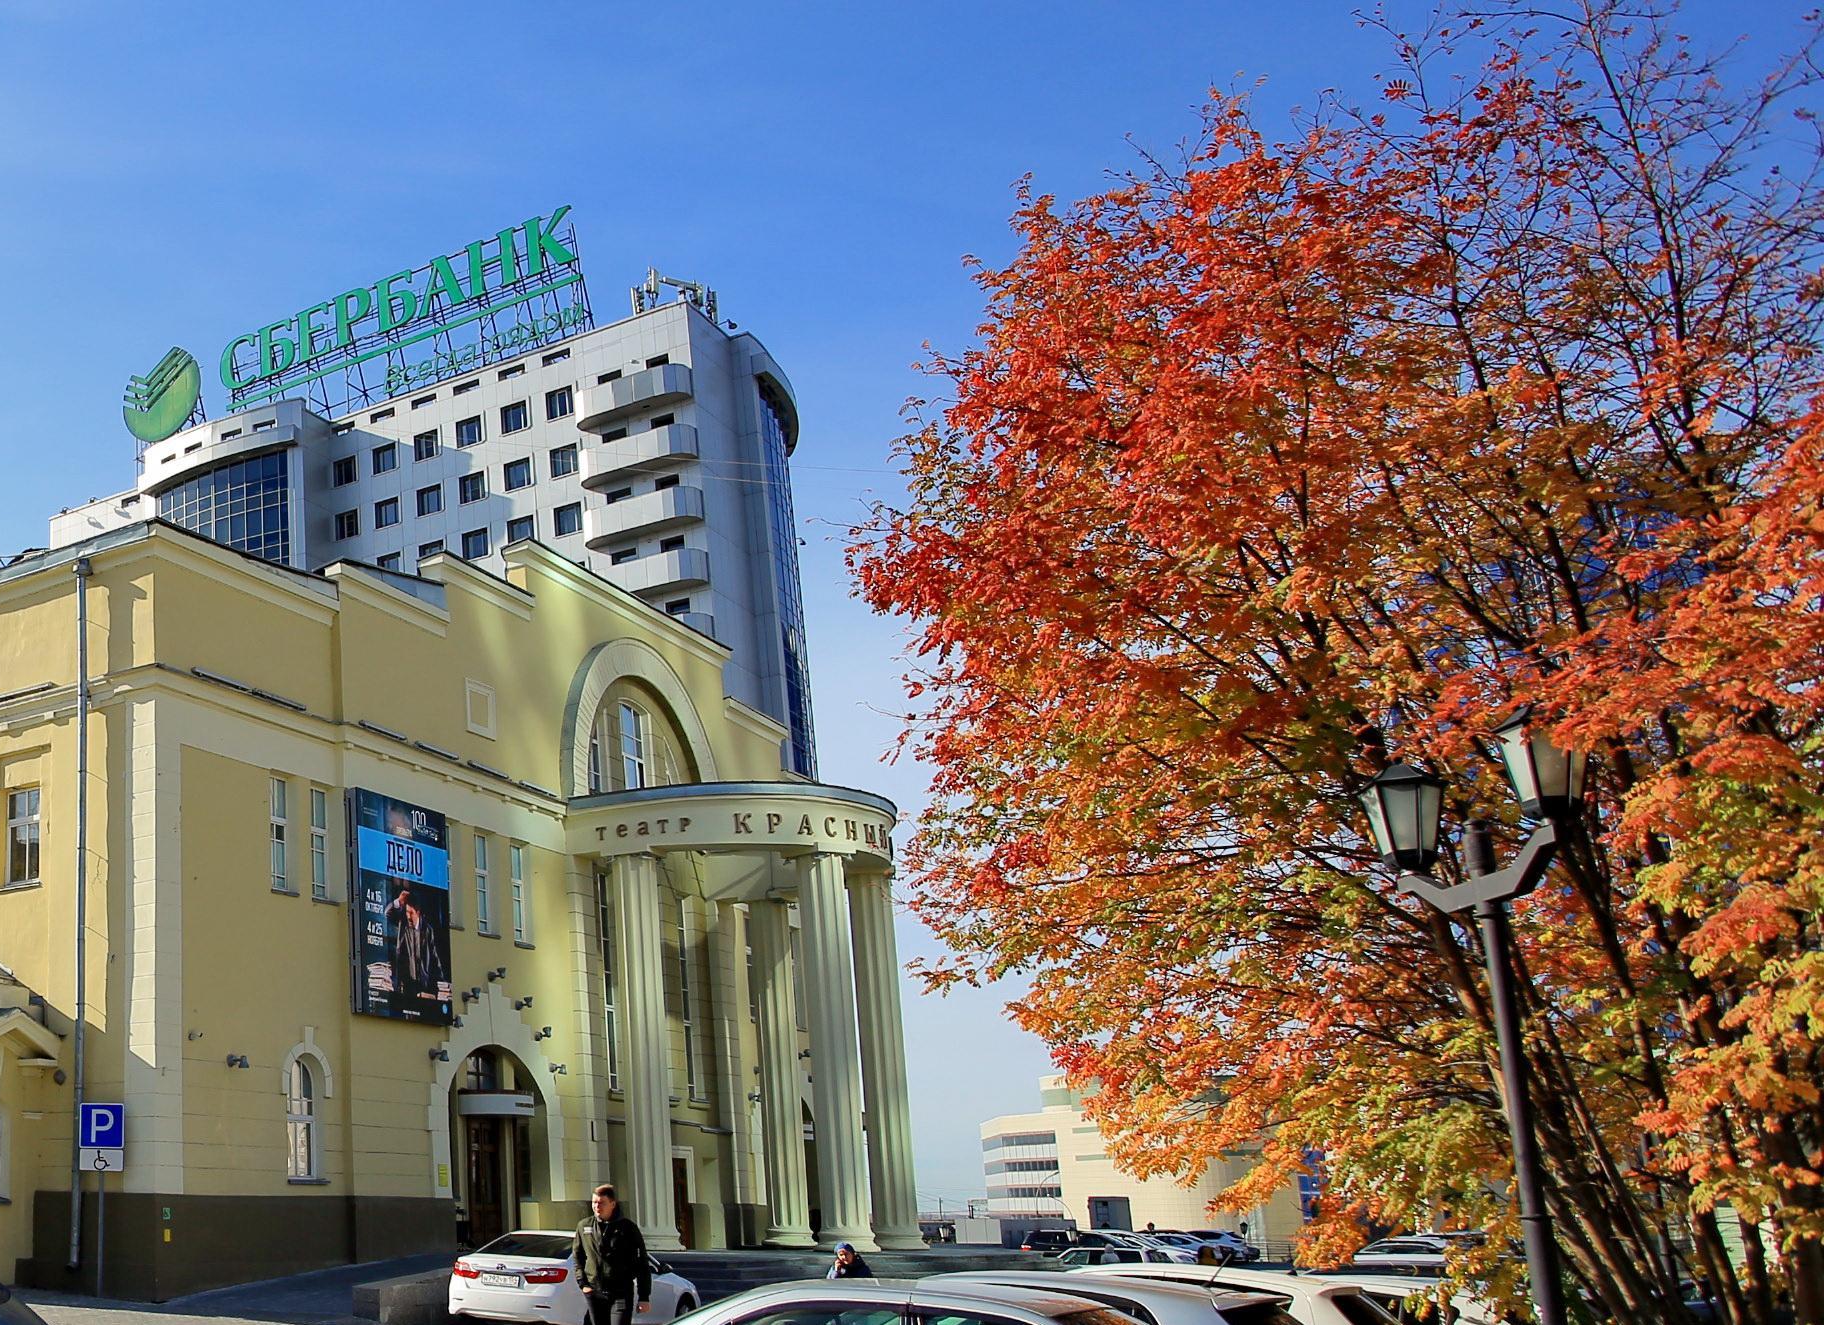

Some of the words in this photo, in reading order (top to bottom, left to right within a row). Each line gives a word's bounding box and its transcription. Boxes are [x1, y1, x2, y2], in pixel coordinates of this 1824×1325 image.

[219, 204, 579, 390] СБЕРБАНК
[382, 342, 477, 395] Всегда
[487, 302, 585, 365] рядом
[411, 809, 427, 831] 100
[733, 812, 888, 850] КРАСНЫЙ
[386, 840, 423, 877] ДЕЛО
[91, 1109, 114, 1143] P
